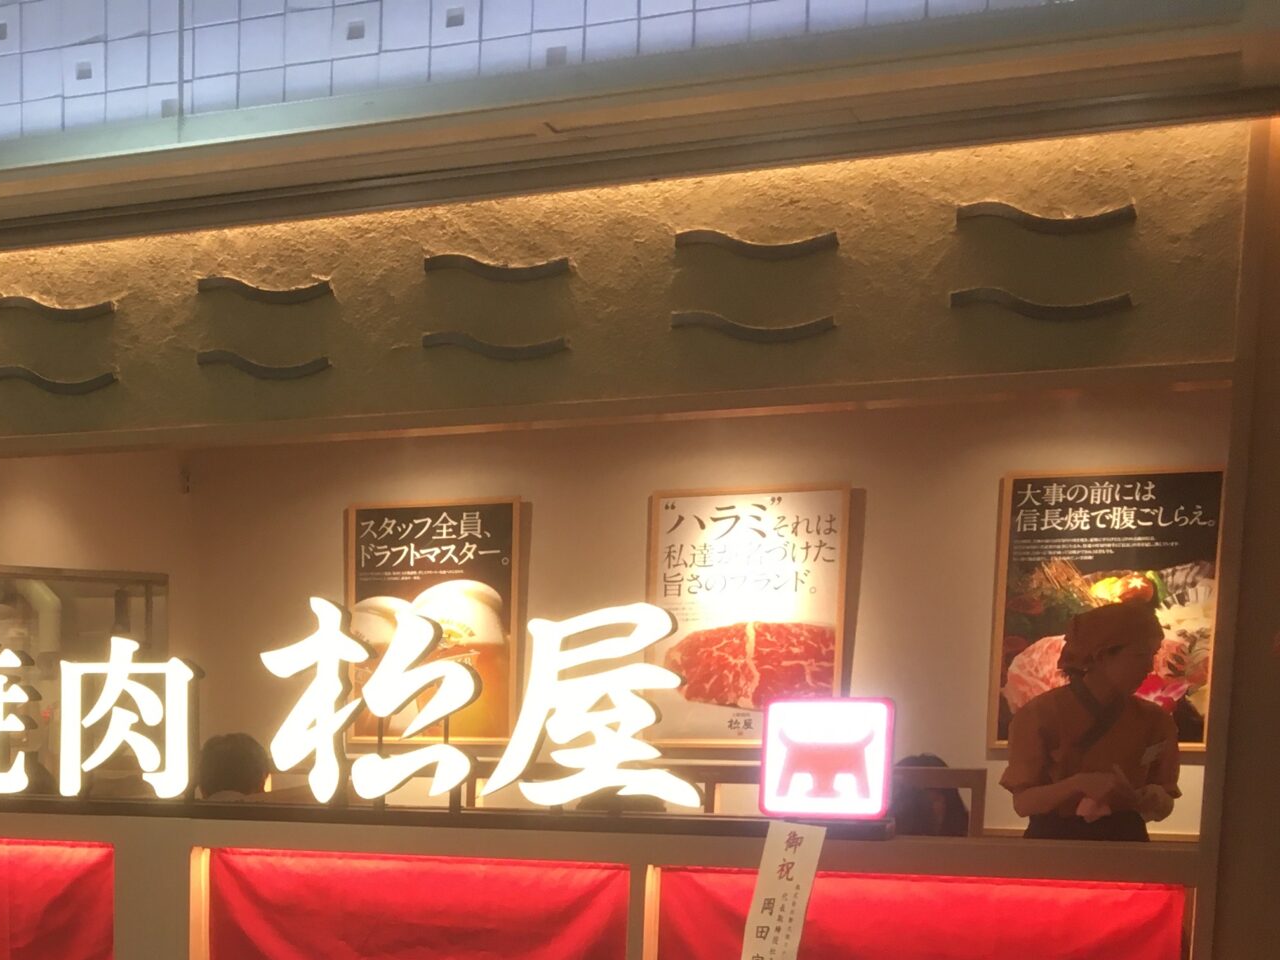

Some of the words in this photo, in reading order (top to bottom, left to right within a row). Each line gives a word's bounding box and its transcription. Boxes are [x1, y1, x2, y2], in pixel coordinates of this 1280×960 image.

[1017, 481, 1157, 507] 大事の前には
[359, 511, 492, 541] スタッフ全員、
[1015, 505, 1216, 532] 信長焼で腹ごしらえ。
[361, 542, 510, 568] ドラフトマスター。
[260, 595, 702, 810] 松屋
[776, 830, 804, 882] 御祝
